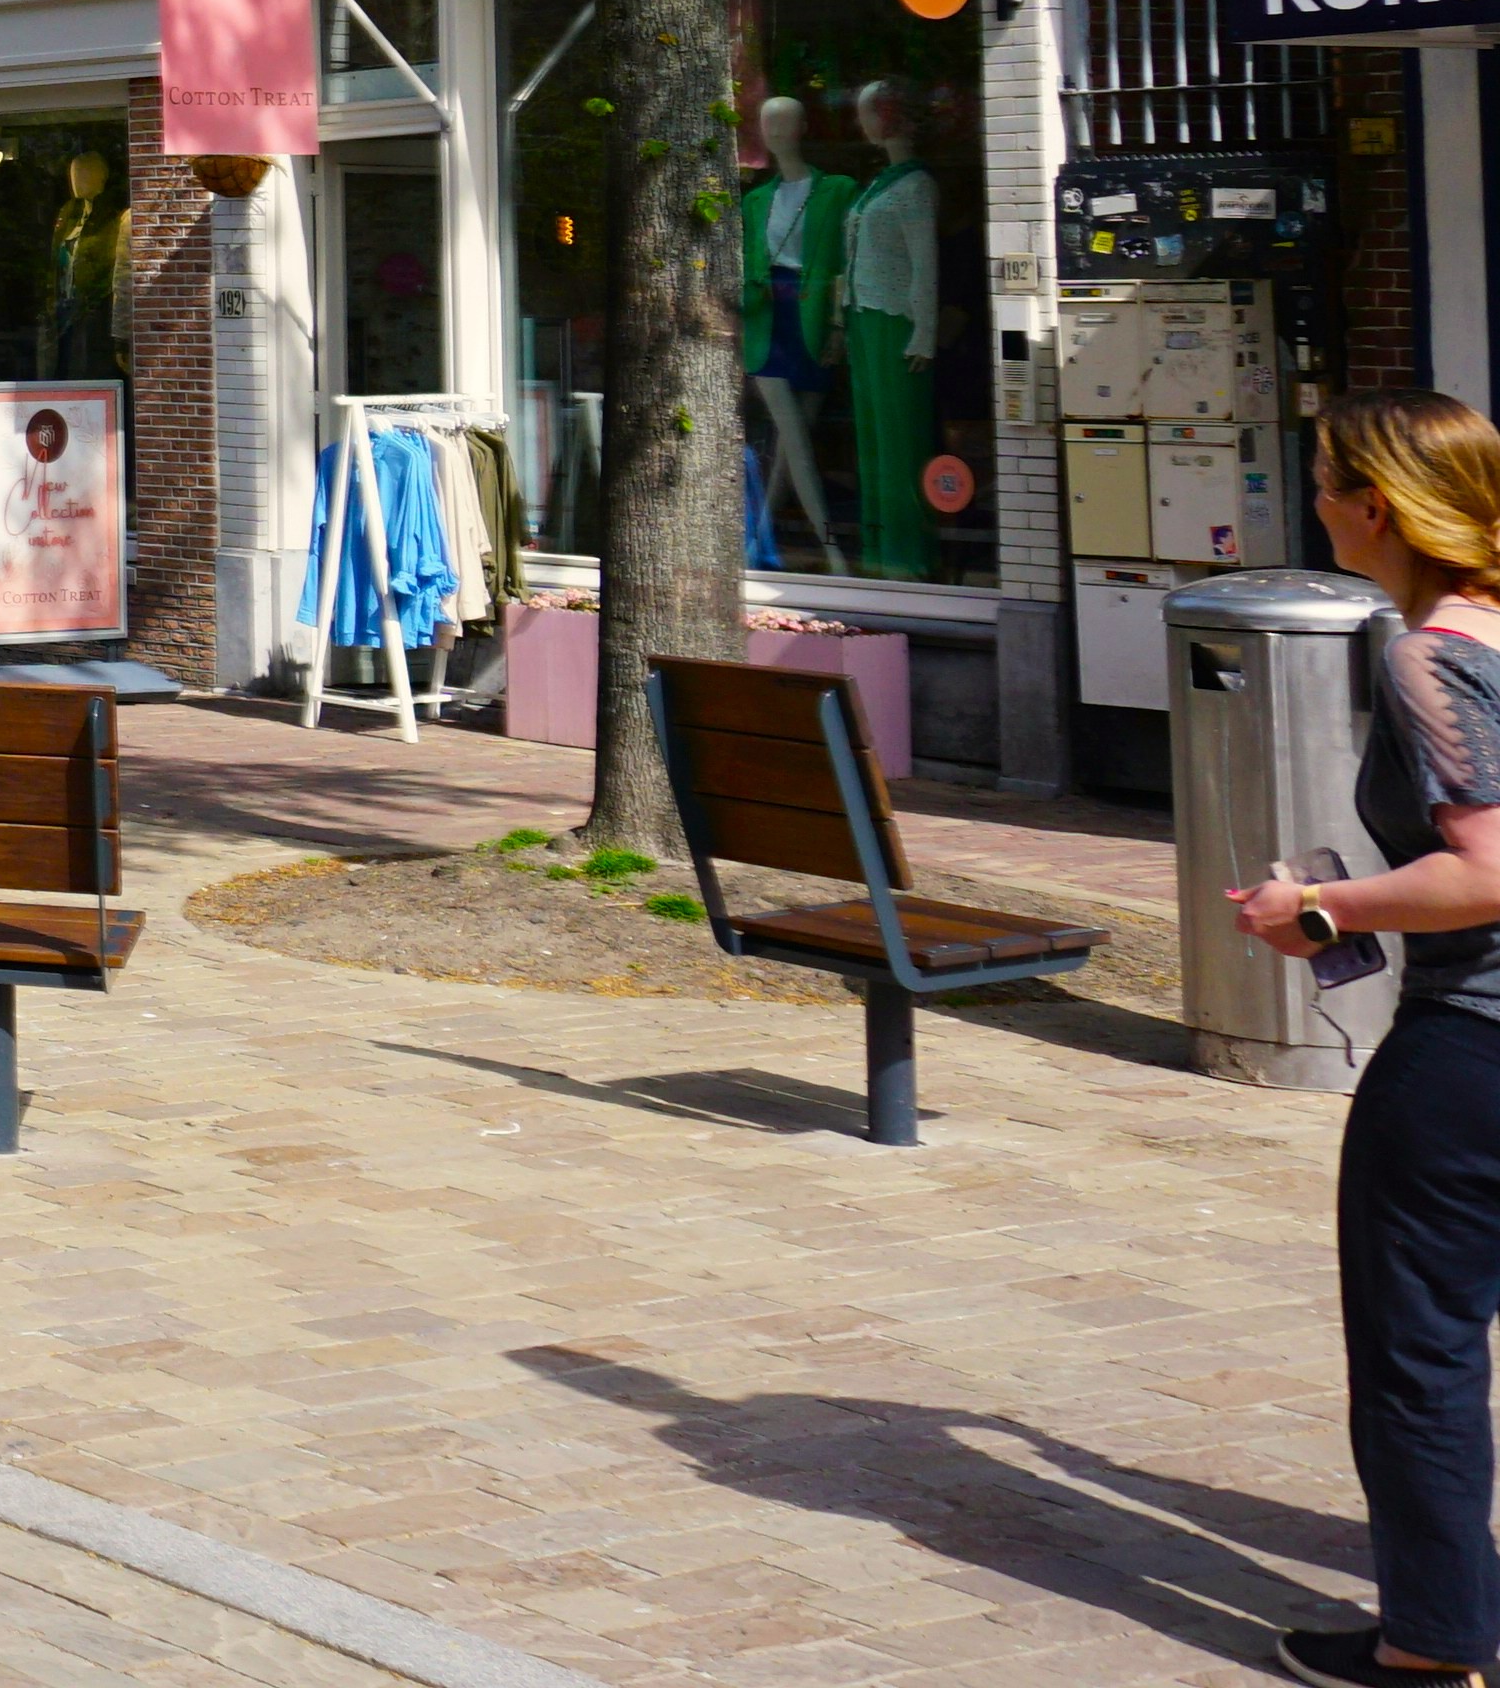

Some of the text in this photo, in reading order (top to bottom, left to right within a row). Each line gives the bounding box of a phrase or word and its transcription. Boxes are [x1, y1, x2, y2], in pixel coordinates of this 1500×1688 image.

[168, 85, 315, 108] COTTON TREAT
[221, 290, 242, 316] 192
[4, 478, 96, 537] Collection
[2, 588, 103, 605] COTTON TREAT
